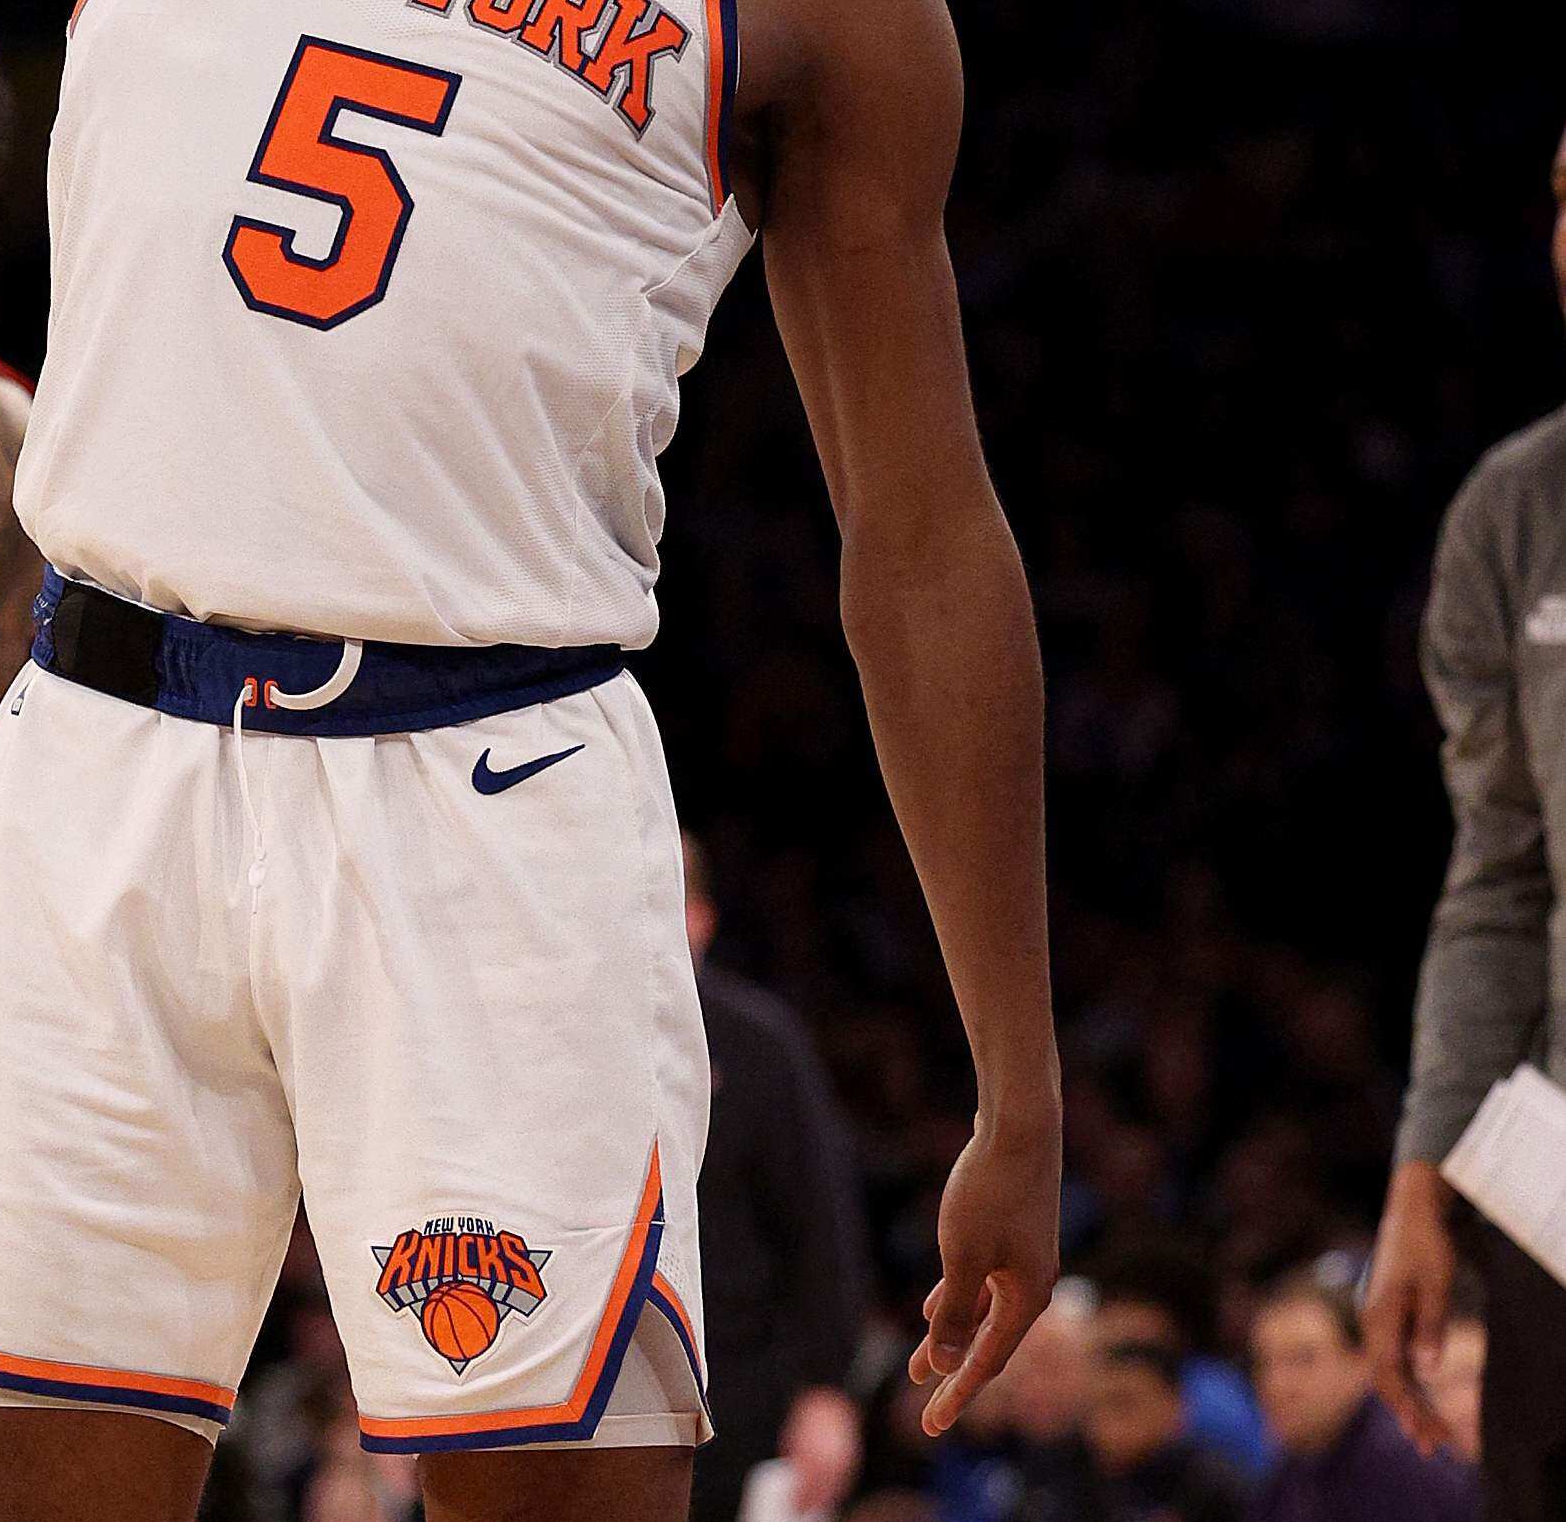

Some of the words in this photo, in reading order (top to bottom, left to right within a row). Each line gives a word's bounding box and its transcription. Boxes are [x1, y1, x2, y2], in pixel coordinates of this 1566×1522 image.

[222, 34, 462, 331] 5
[424, 1217, 454, 1234] NEW
[458, 1217, 495, 1234] YORK
[376, 1229, 547, 1301] KNICKS
